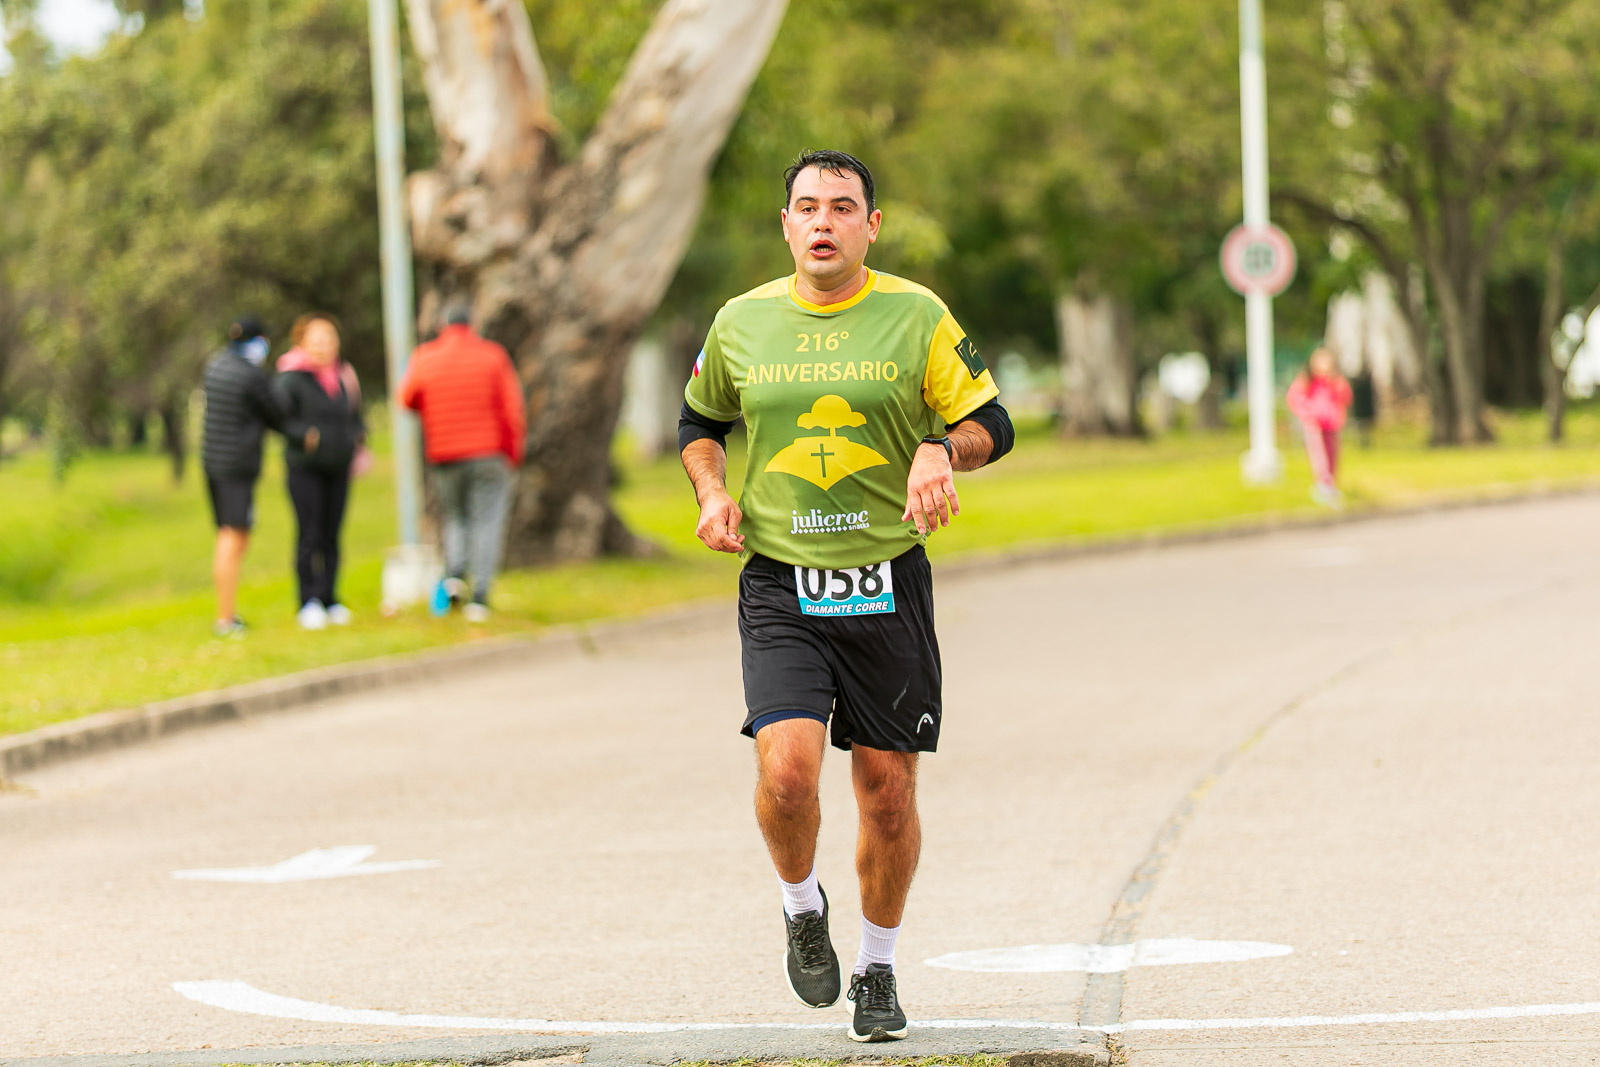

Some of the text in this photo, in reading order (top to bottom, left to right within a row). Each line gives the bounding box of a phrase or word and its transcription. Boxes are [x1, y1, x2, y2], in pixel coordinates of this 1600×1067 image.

[795, 330, 850, 353] 216°
[745, 360, 899, 386] ANIVERSARIO
[790, 508, 869, 535] julicroc
[801, 562, 884, 601] 058
[805, 601, 889, 614] DIAMANTE CORRE
